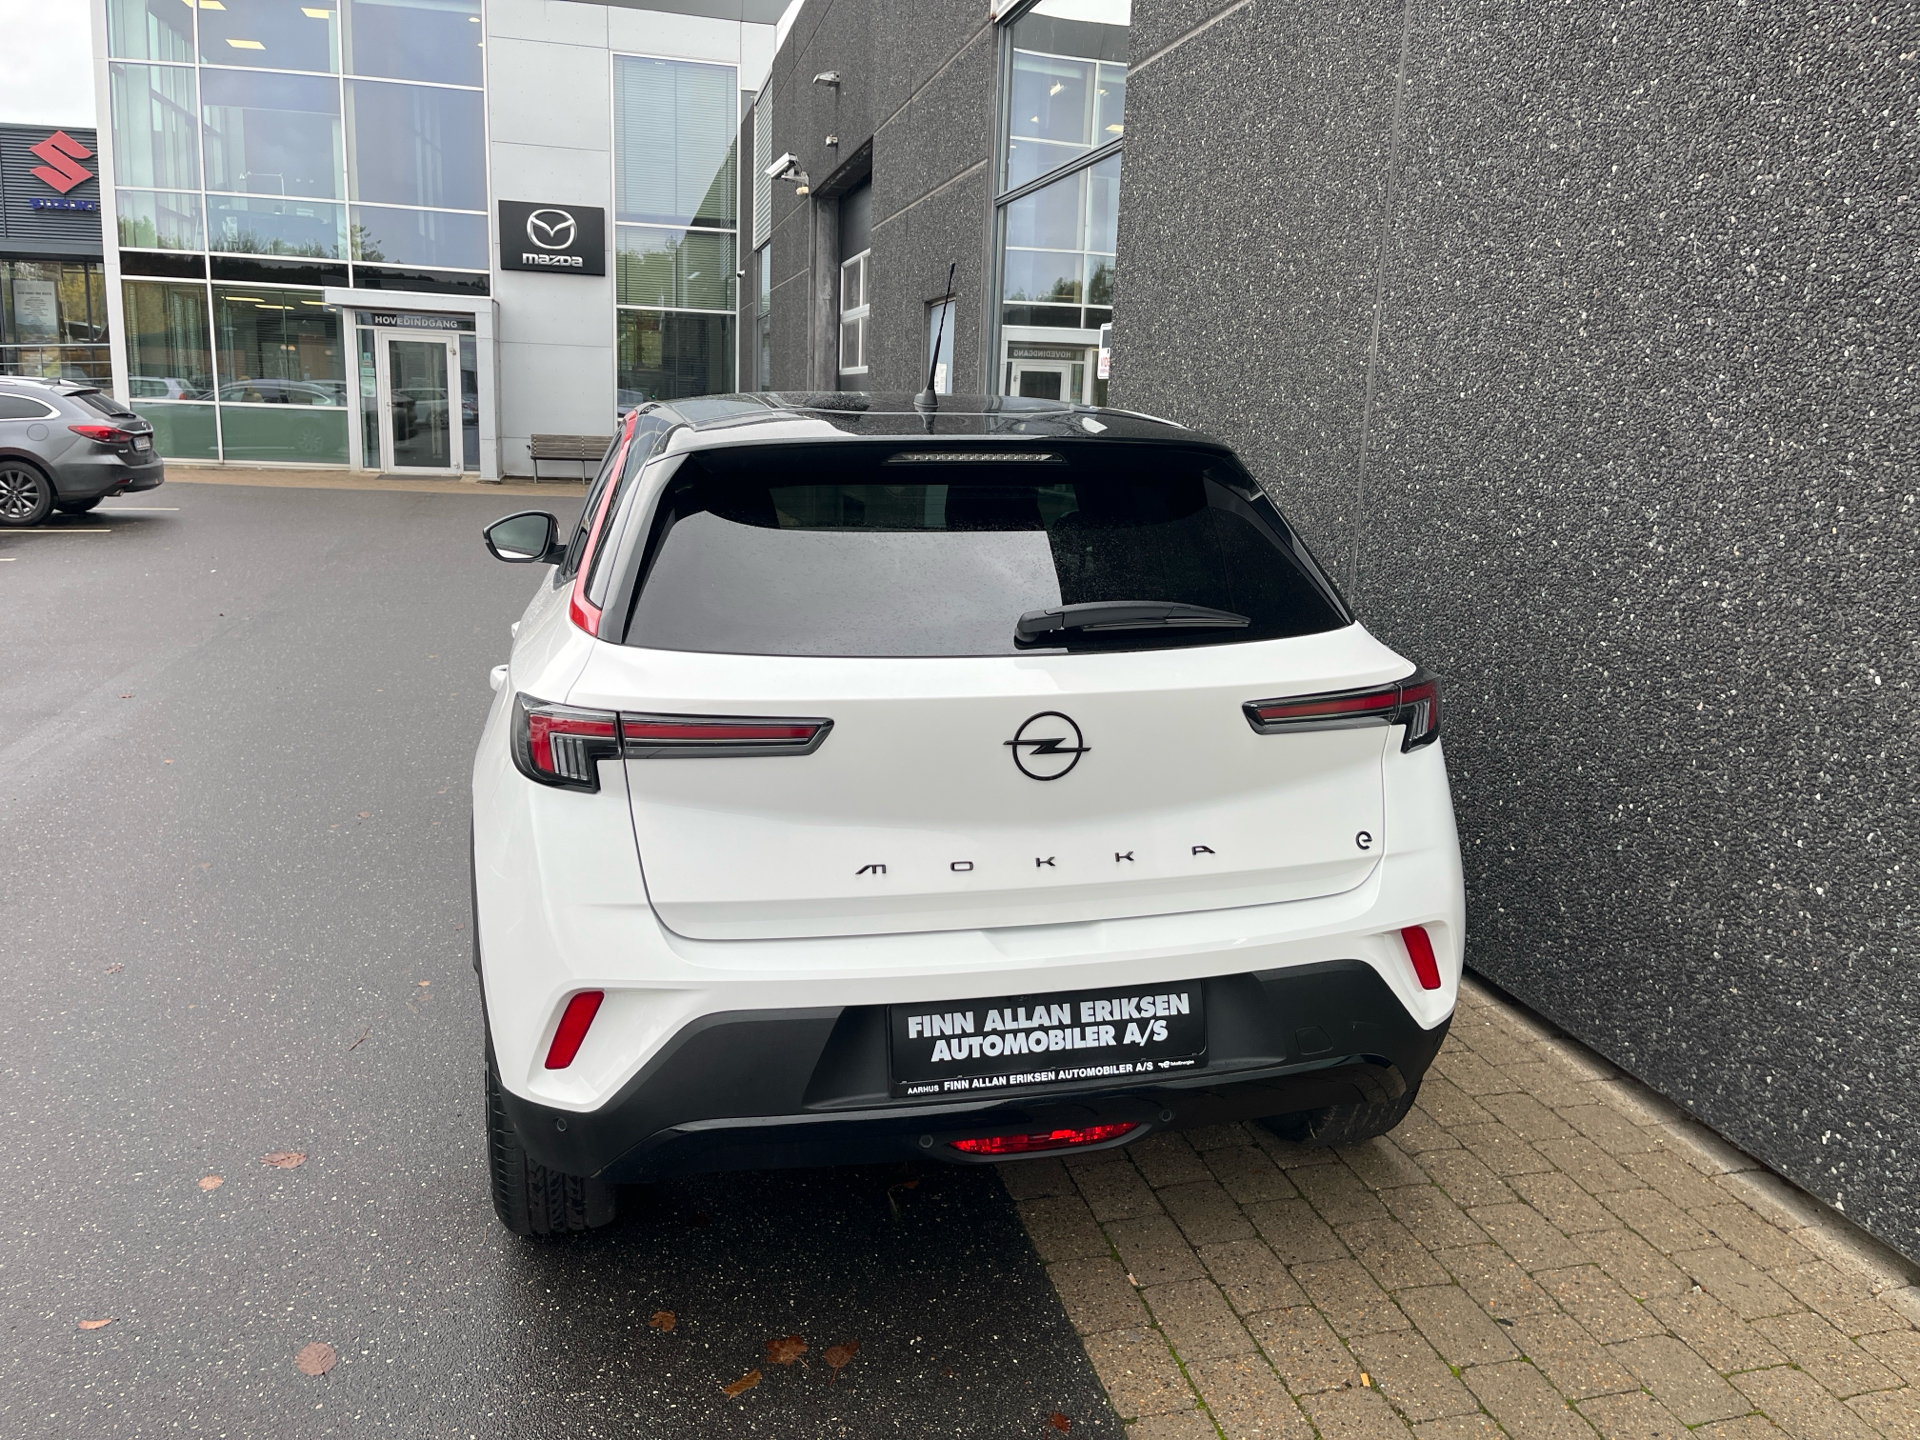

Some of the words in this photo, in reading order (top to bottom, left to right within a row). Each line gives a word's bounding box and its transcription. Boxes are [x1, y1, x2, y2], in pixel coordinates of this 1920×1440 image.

[375, 316, 458, 328] HOVEDINDGANG
[856, 845, 1216, 875] MOKKA
[908, 1012, 975, 1039] FINN
[984, 1004, 1071, 1031] ALLAN
[1080, 994, 1190, 1023] ERIKSEN
[931, 1025, 1116, 1062] AUTOMOBILER
[1123, 1019, 1168, 1047] A/S
[907, 1084, 940, 1095] AARHUS
[944, 1079, 969, 1091] FINN
[972, 1075, 1006, 1089] ALLAN
[1009, 1071, 1055, 1085] ERIKSEN
[1058, 1063, 1133, 1080] AUTOMOBILER
[1136, 1061, 1153, 1072] A/S
